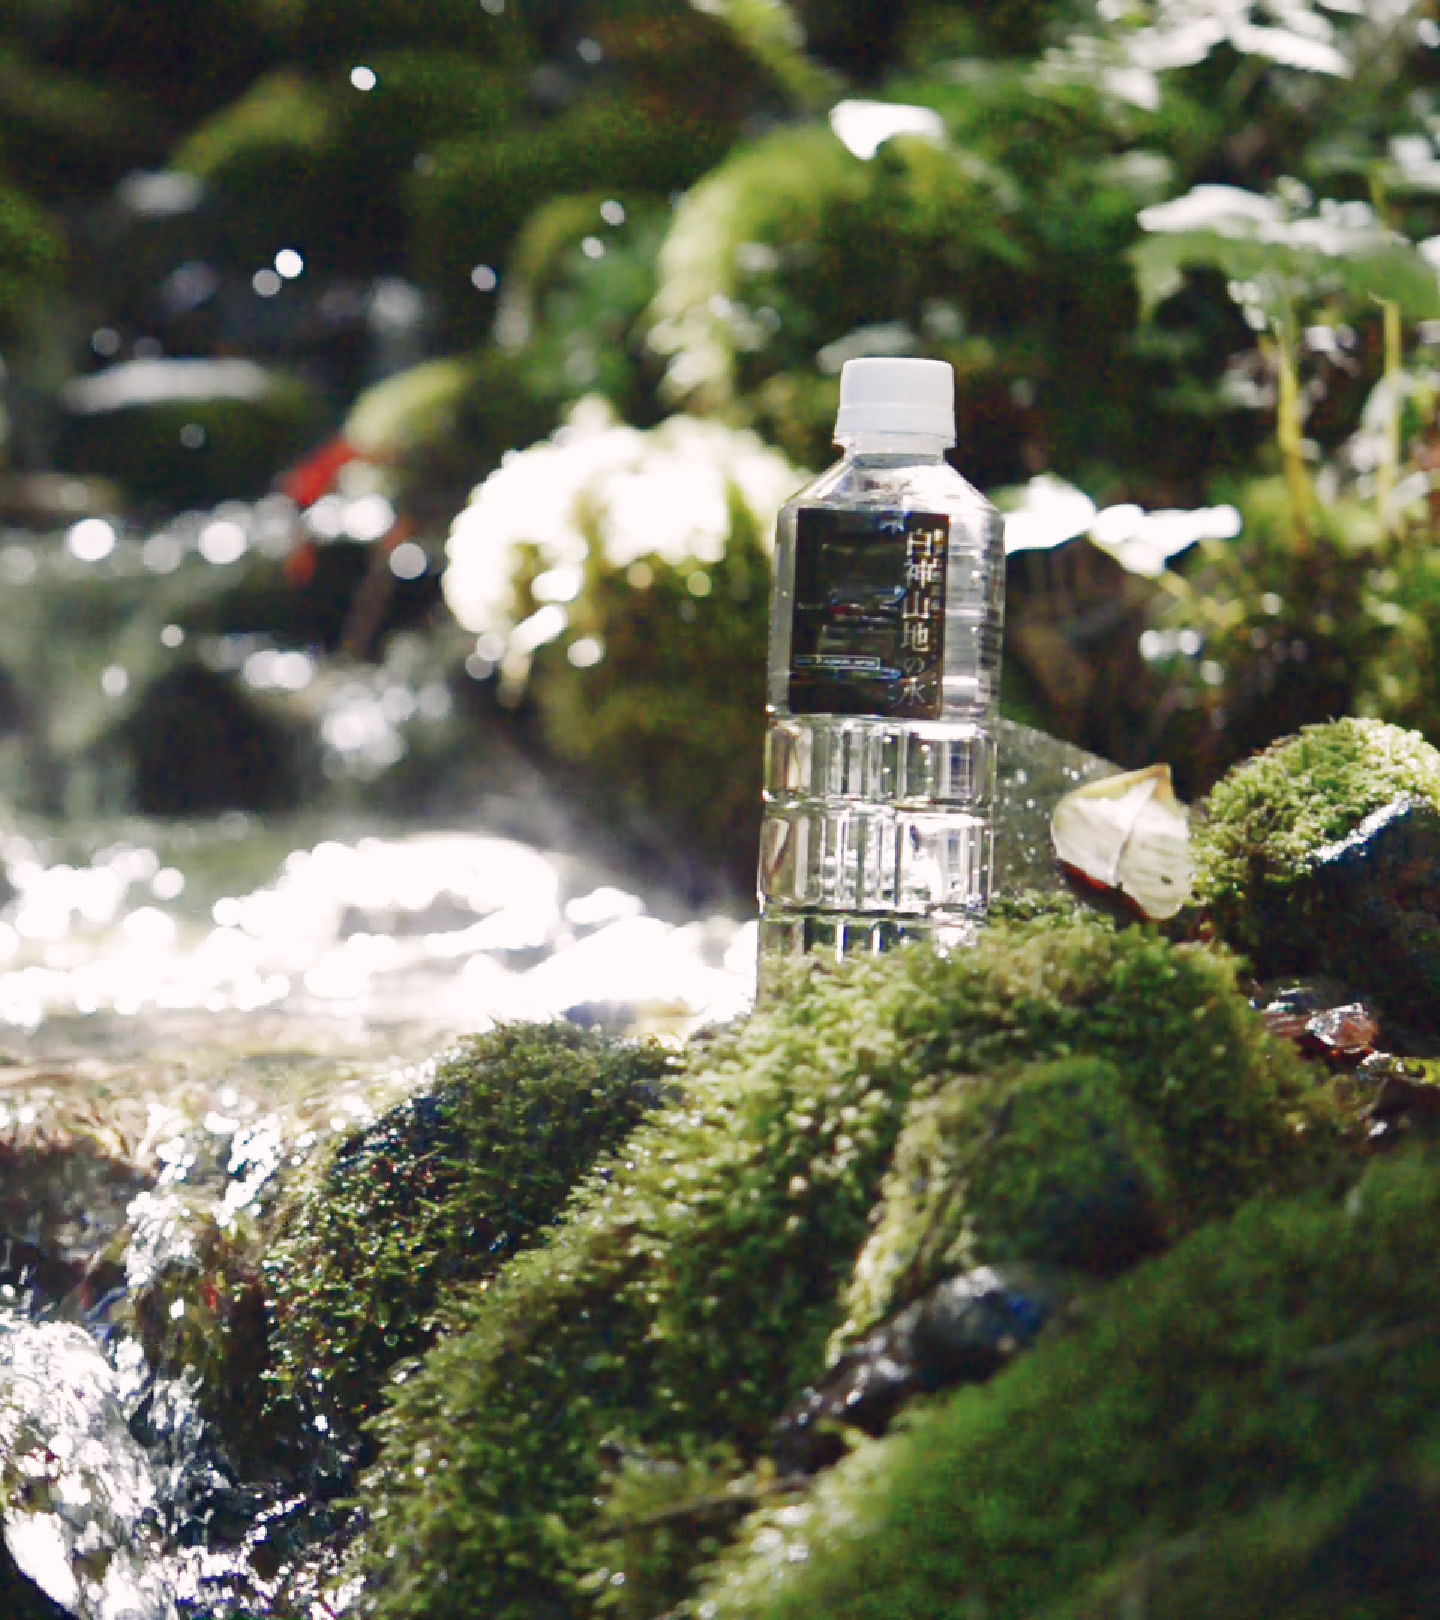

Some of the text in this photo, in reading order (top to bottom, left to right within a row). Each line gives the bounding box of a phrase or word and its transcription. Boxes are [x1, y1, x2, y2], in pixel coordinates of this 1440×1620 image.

[900, 528, 932, 706] 白神山地の水
